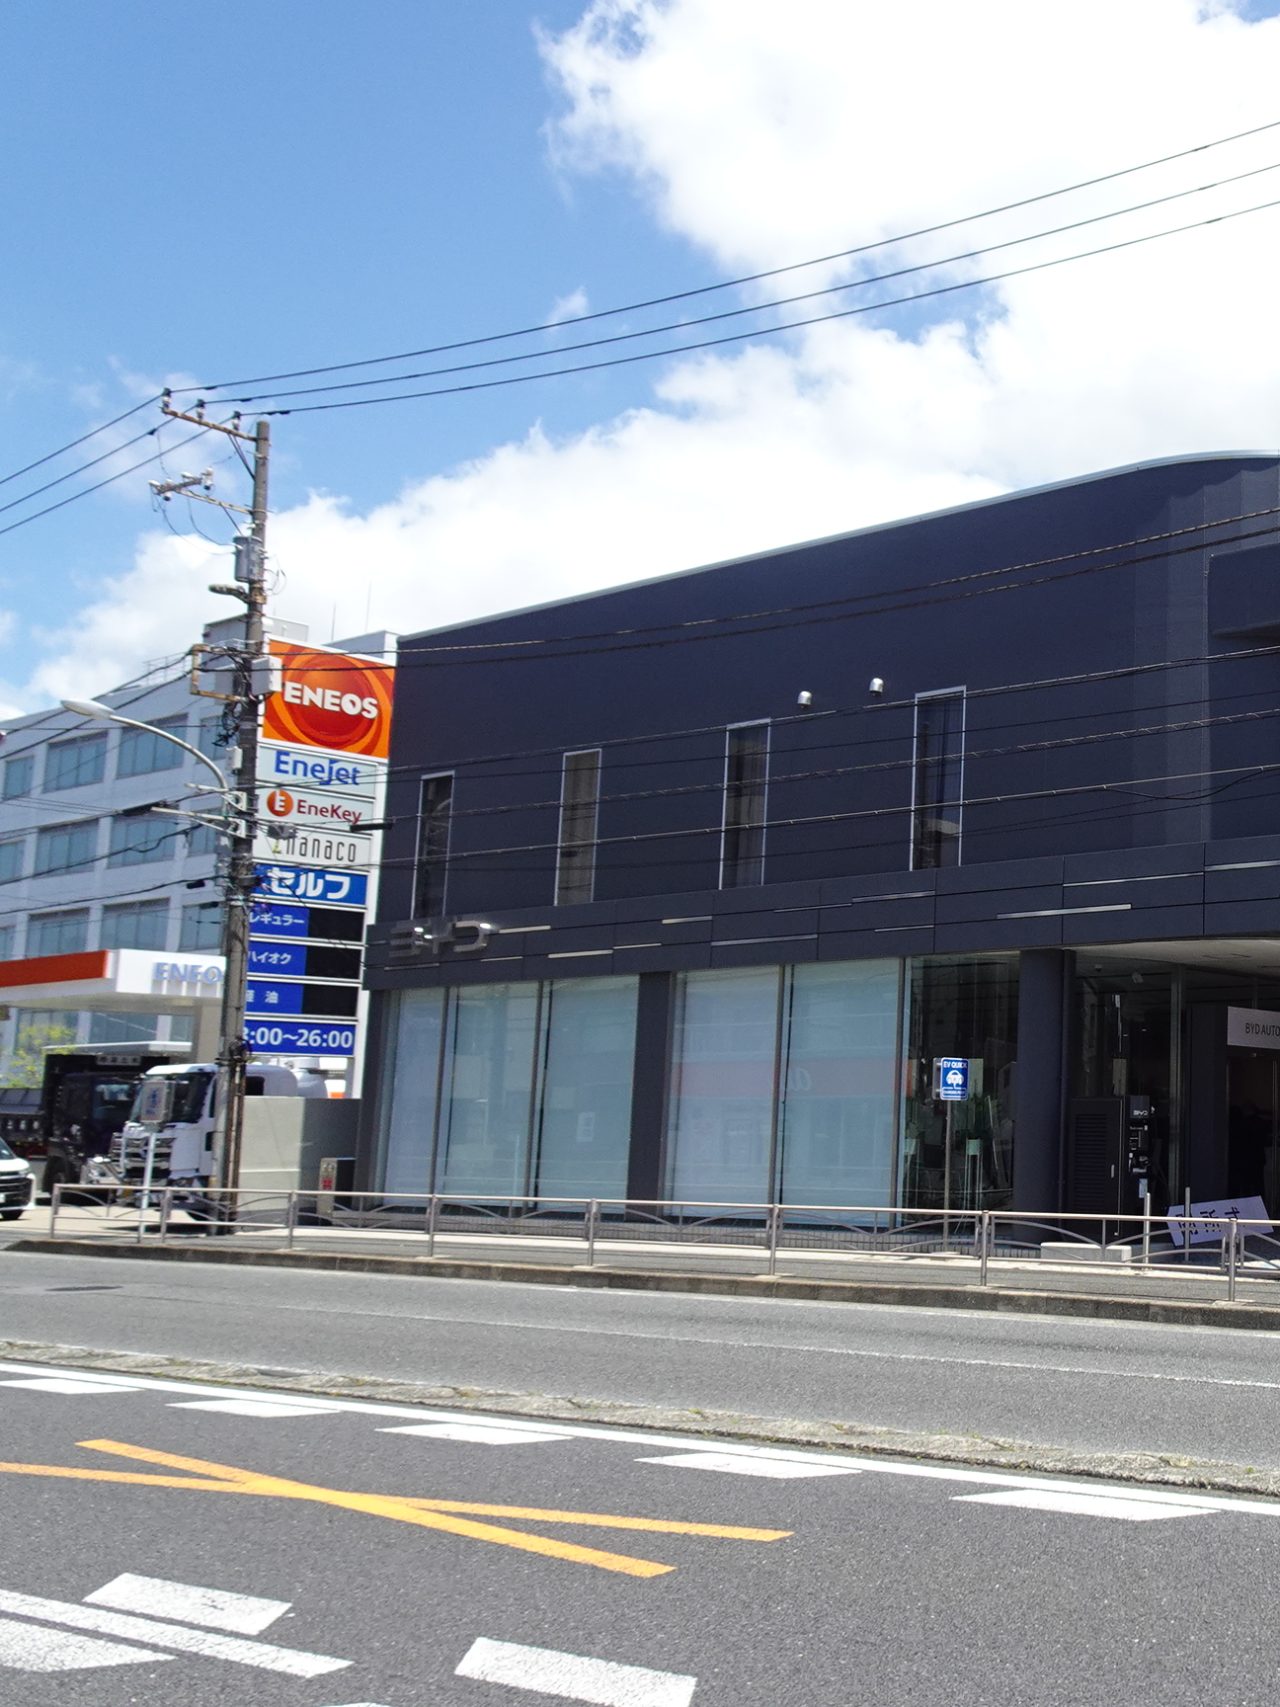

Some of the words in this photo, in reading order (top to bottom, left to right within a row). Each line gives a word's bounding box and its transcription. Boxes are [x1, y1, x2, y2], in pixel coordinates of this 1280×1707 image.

[284, 681, 379, 719] ENEOS
[297, 799, 362, 825] EneKey
[267, 867, 351, 900] セルフ
[249, 911, 305, 926] レギュラー
[389, 918, 493, 958] BYD
[154, 961, 223, 984] ENEO
[1261, 1024, 1280, 1037] AUTO
